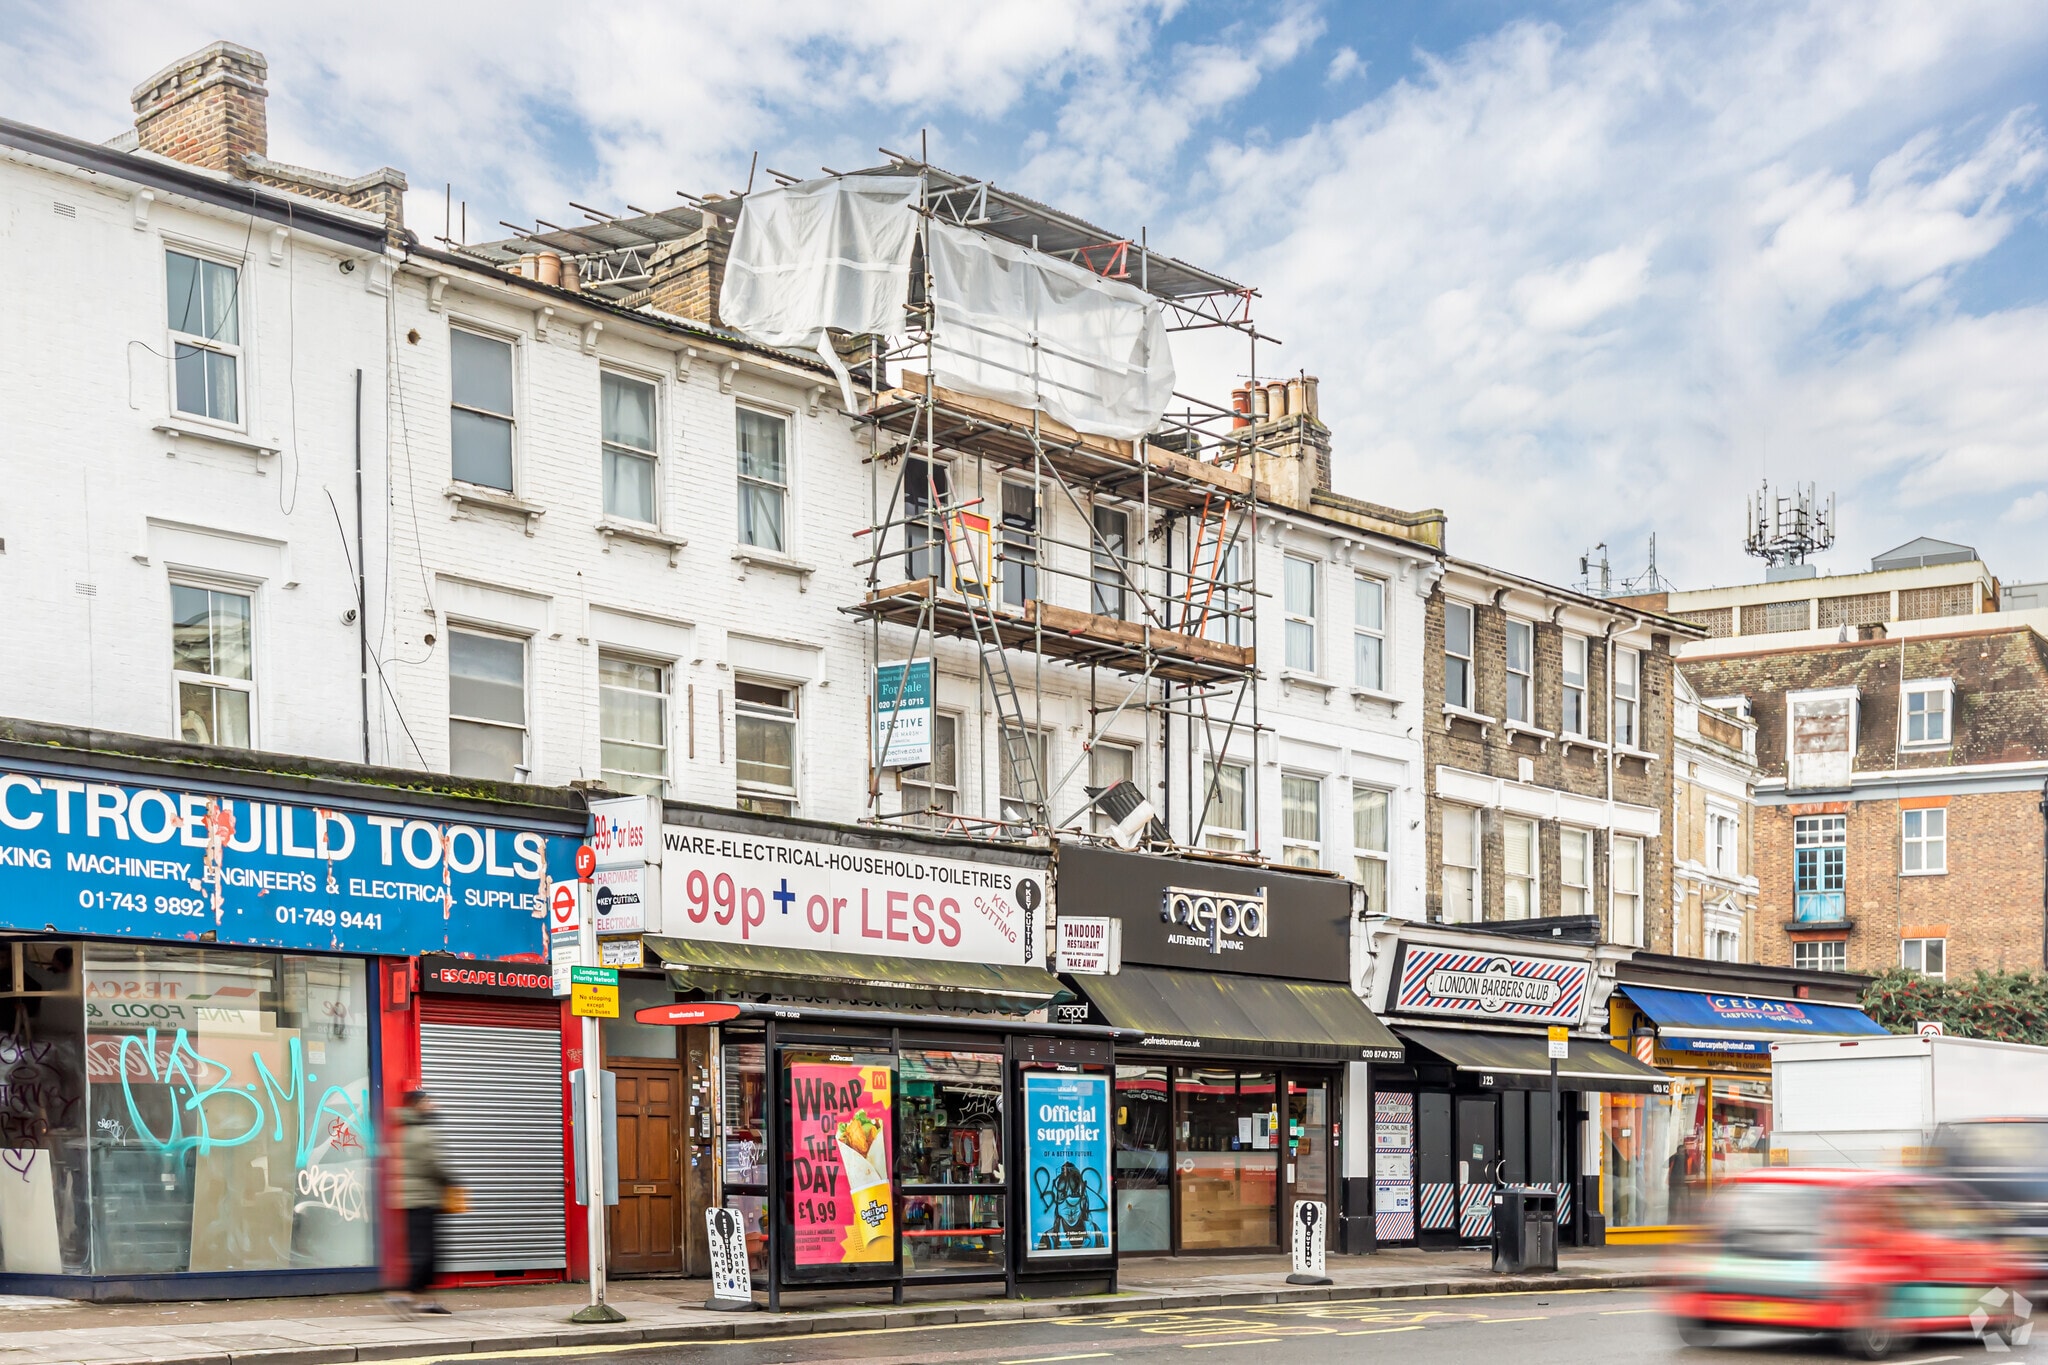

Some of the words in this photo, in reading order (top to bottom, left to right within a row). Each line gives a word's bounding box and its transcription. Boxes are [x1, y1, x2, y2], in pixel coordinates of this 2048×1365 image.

[880, 718, 923, 730] BECTIVE
[628, 821, 643, 847] less
[367, 815, 547, 880] TOOLS
[578, 855, 589, 869] LF
[0, 846, 51, 869] KING
[326, 878, 339, 894] &
[350, 878, 457, 905] ELECTRICAL
[465, 889, 545, 912] SUPPLIES
[597, 870, 638, 884] HARDWARE
[79, 888, 146, 913] 01-743
[154, 895, 205, 917] 9892
[600, 897, 612, 905] KEY
[613, 894, 638, 904] CUTTING
[991, 893, 1014, 918] KEY
[275, 906, 336, 927] 01-749
[340, 912, 382, 930] 9441
[597, 916, 639, 930] ELECTRICAL
[807, 893, 847, 935] or
[861, 887, 961, 947] LESS
[974, 896, 1017, 943] CUTTING
[1064, 924, 1104, 938] TANDOORI
[1168, 934, 1211, 947] AUTHENTIC
[1067, 940, 1099, 949] RESTAURANT
[1067, 958, 1081, 968] TAKE
[1082, 959, 1098, 968] AWAY
[440, 968, 496, 985] ESCAPE
[573, 974, 593, 984] Priority
[594, 976, 616, 984] Network
[1439, 975, 1479, 994] LONDON
[1481, 978, 1523, 998] BARBERS
[1525, 982, 1550, 1001] CLUB
[1715, 998, 1788, 1014] CEDAR
[1362, 1050, 1373, 1058] 020
[1374, 1050, 1388, 1059] 8740
[1389, 1051, 1402, 1059] 7551
[794, 1077, 862, 1122] WRAP
[821, 1112, 837, 1134] OF
[1039, 1104, 1096, 1123] Official
[1037, 1124, 1100, 1146] supplier
[804, 1135, 838, 1163] THE
[793, 1157, 839, 1198] DAY
[798, 1198, 837, 1225] £1.99
[707, 1208, 721, 1290] HARDWARE
[734, 1210, 748, 1292] ELECTRICAL
